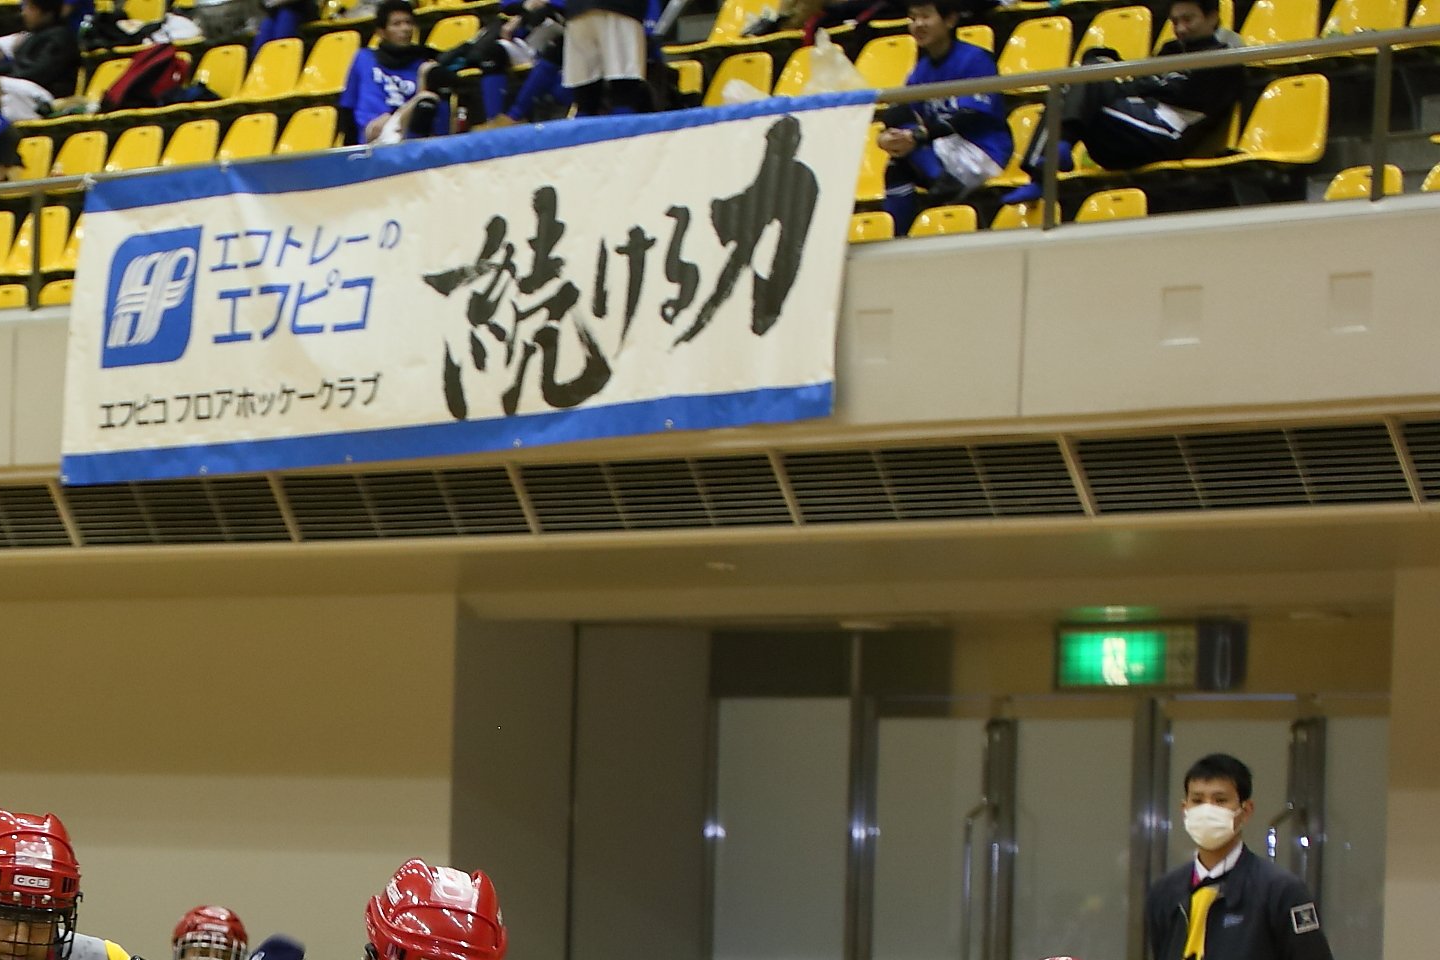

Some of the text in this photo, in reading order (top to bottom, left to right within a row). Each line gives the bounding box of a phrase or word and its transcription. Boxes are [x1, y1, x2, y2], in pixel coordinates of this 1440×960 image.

[210, 219, 402, 272] エコトレーの
[422, 115, 820, 420] 続ける力
[212, 268, 374, 344] エフピコ
[98, 372, 383, 429] エフピコ フロアホッケークラブ
[15, 876, 50, 888] CCM
